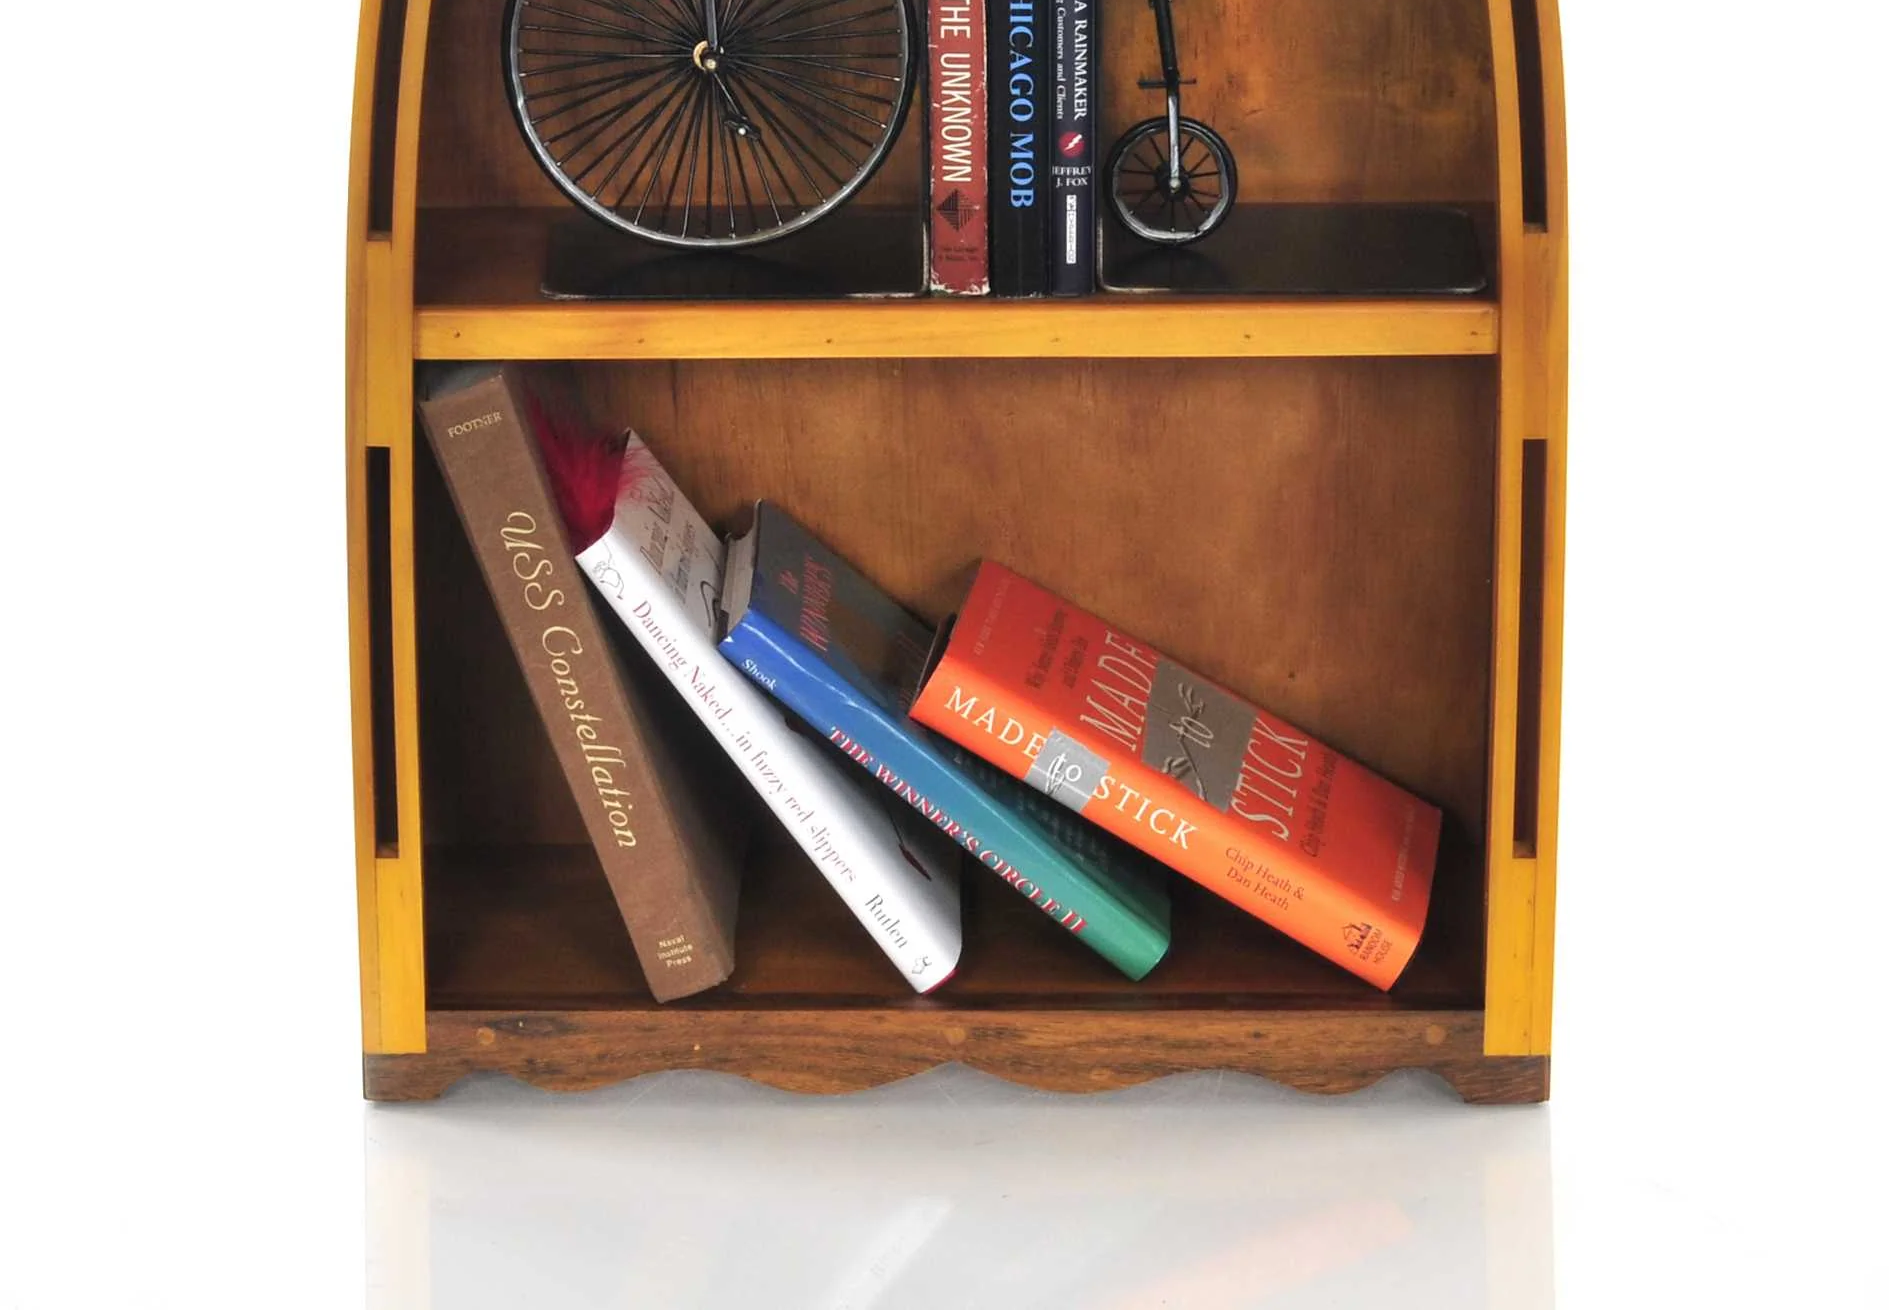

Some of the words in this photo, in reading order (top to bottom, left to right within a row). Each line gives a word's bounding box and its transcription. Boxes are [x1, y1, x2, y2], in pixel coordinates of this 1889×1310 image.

[1056, 7, 1067, 60] Customers
[1074, 1, 1088, 13] A
[1056, 63, 1067, 82] and
[1056, 85, 1067, 120] Clients
[1074, 19, 1088, 121] RAINMAKER
[939, 53, 973, 182] UNKNOWN
[1009, 133, 1035, 208] MOB
[1056, 177, 1064, 188] J.
[1066, 177, 1088, 187] FOX
[500, 511, 565, 611] USS
[542, 626, 637, 848] Constellation
[1080, 630, 1158, 752] MADE
[632, 599, 688, 671] Dancing
[750, 750, 787, 795] fuzzy
[785, 795, 814, 824] red
[806, 823, 857, 883] slippers
[944, 686, 1048, 760] MADE
[1049, 752, 1082, 783] to
[1092, 774, 1198, 850] STICK
[742, 657, 777, 691] Shook
[829, 725, 877, 767] THE
[875, 762, 980, 853] WINNER'S
[979, 849, 1061, 916] CIRCLE
[1059, 909, 1089, 935] II
[1230, 716, 1310, 842] STICK
[1225, 846, 1254, 872] Chip
[1254, 863, 1292, 896] Heath
[1291, 886, 1305, 901] &
[1226, 866, 1252, 890] Dan
[1252, 883, 1290, 912] Heath
[665, 955, 692, 968] Press
